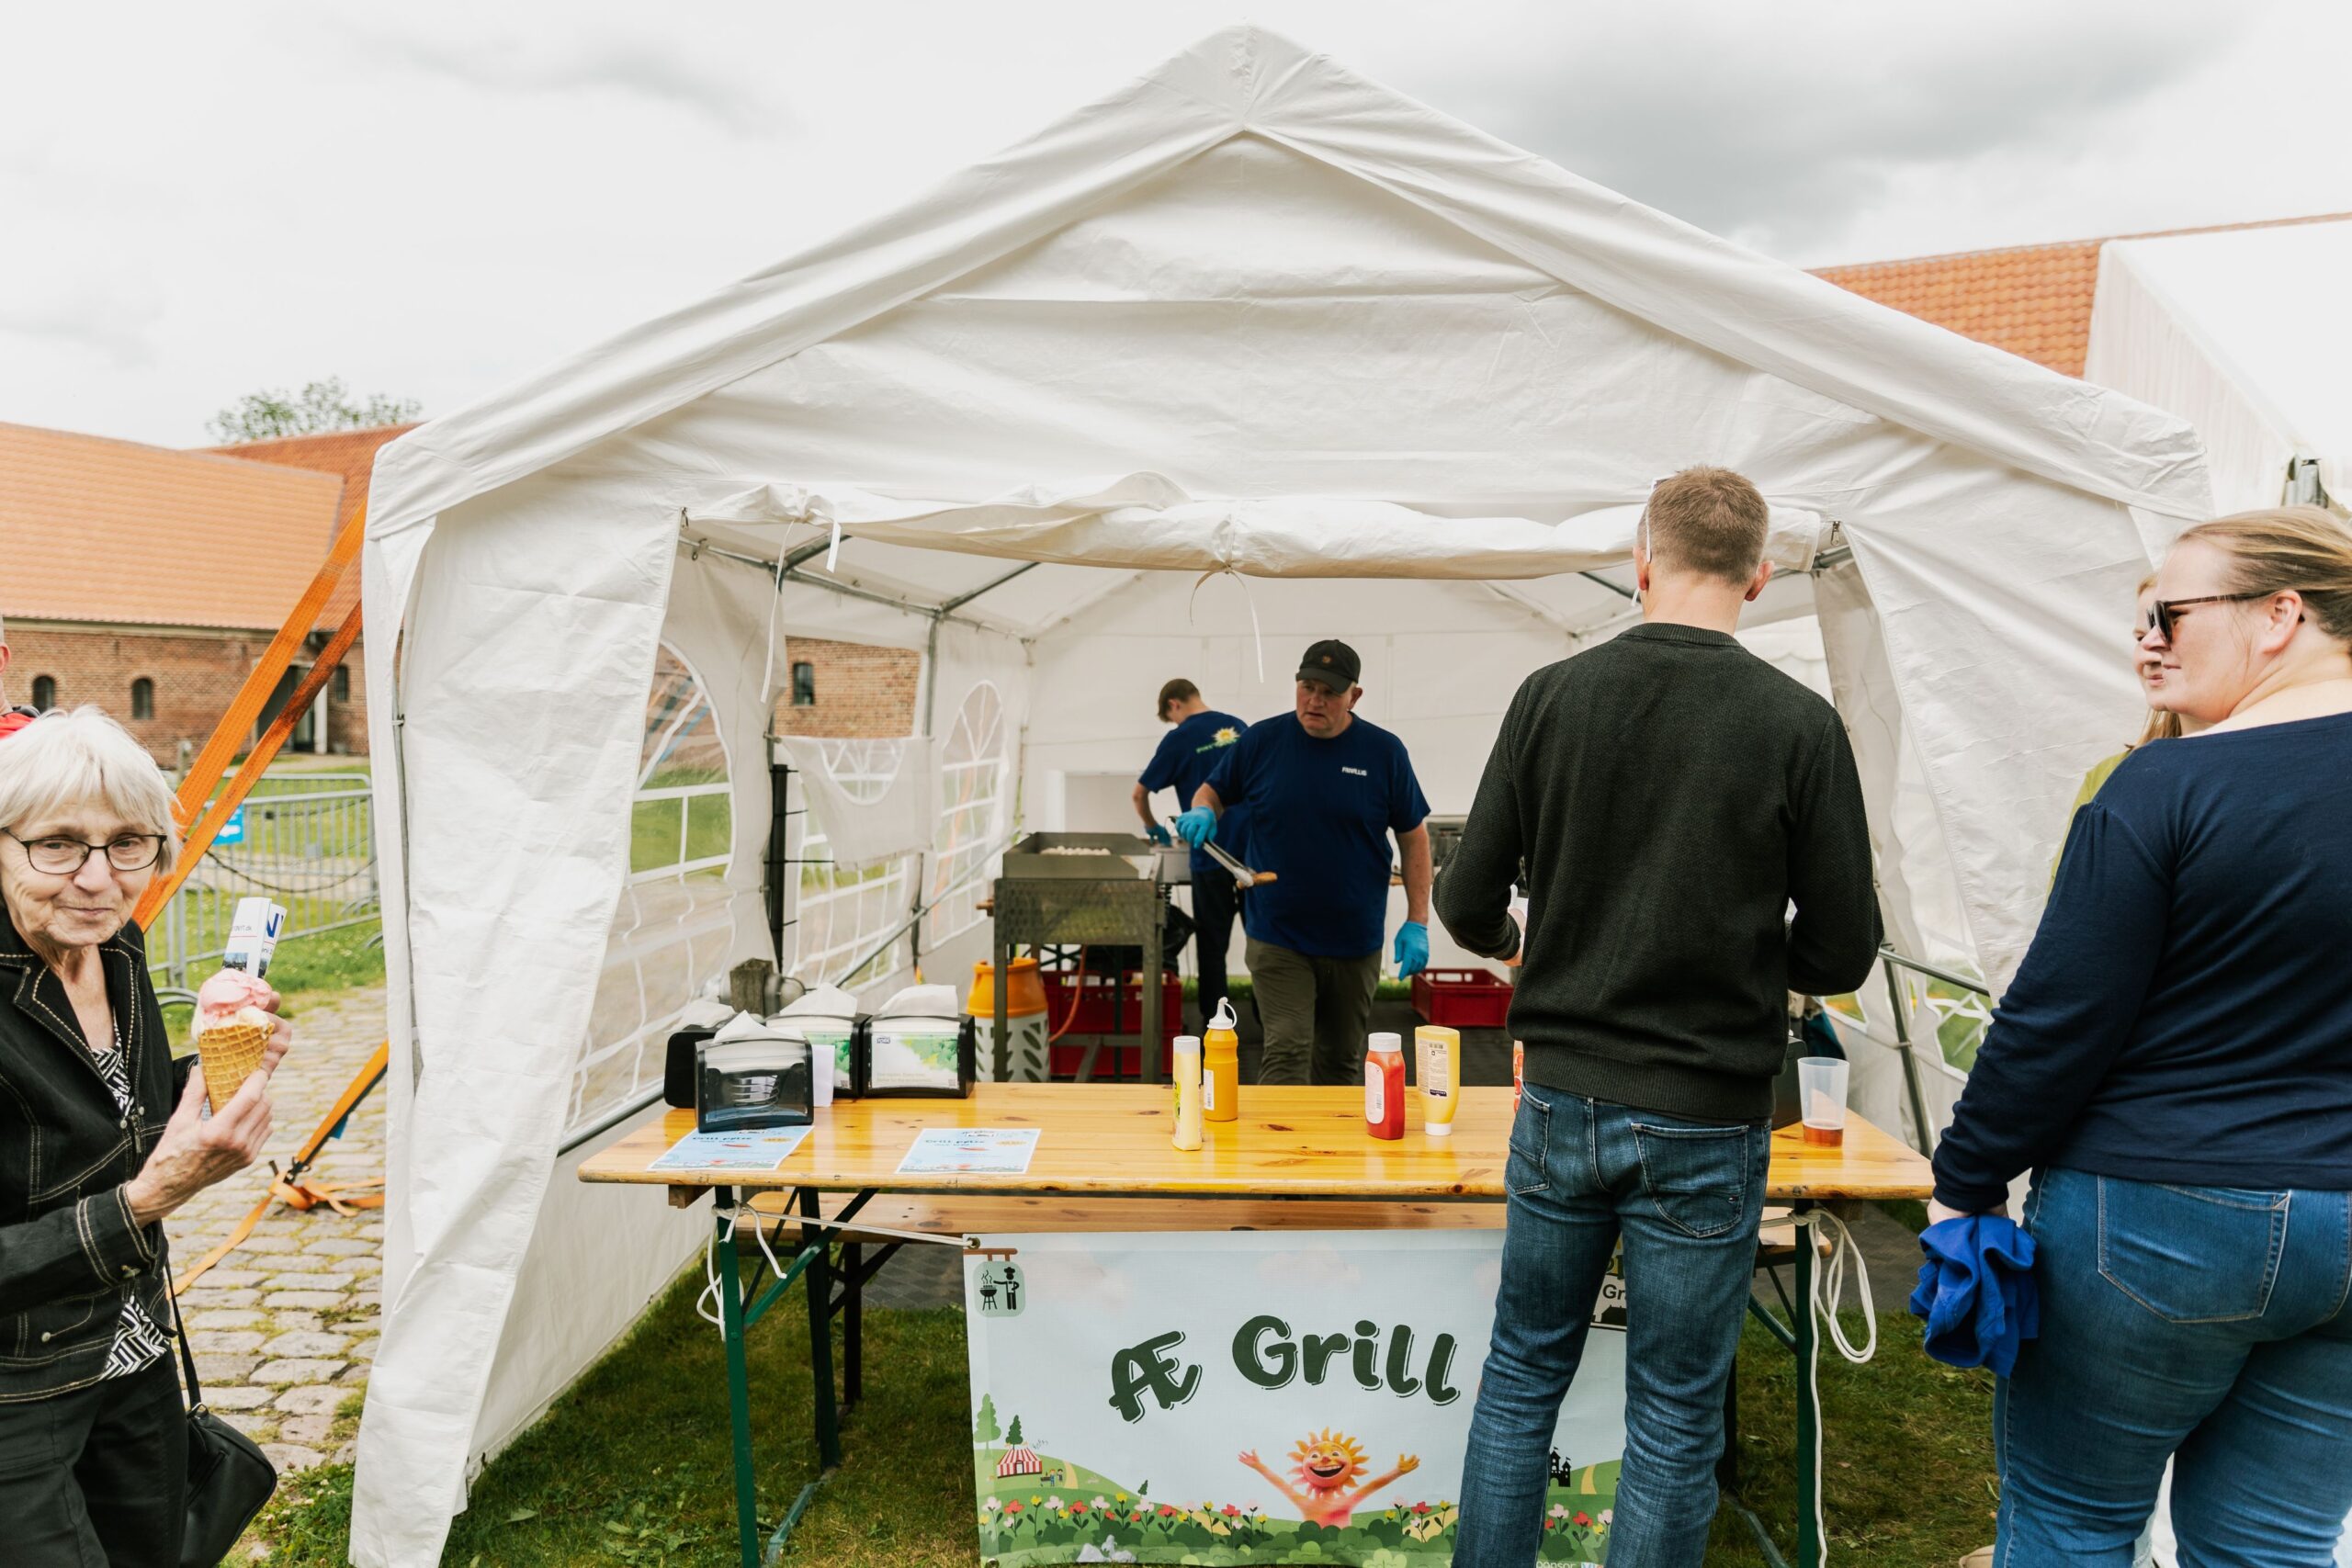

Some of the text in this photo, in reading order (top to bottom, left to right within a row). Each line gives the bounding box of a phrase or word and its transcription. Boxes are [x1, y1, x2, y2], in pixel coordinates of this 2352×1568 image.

[1602, 1283, 1626, 1301] Gr
[1108, 1315, 1461, 1424] Æ Grill
